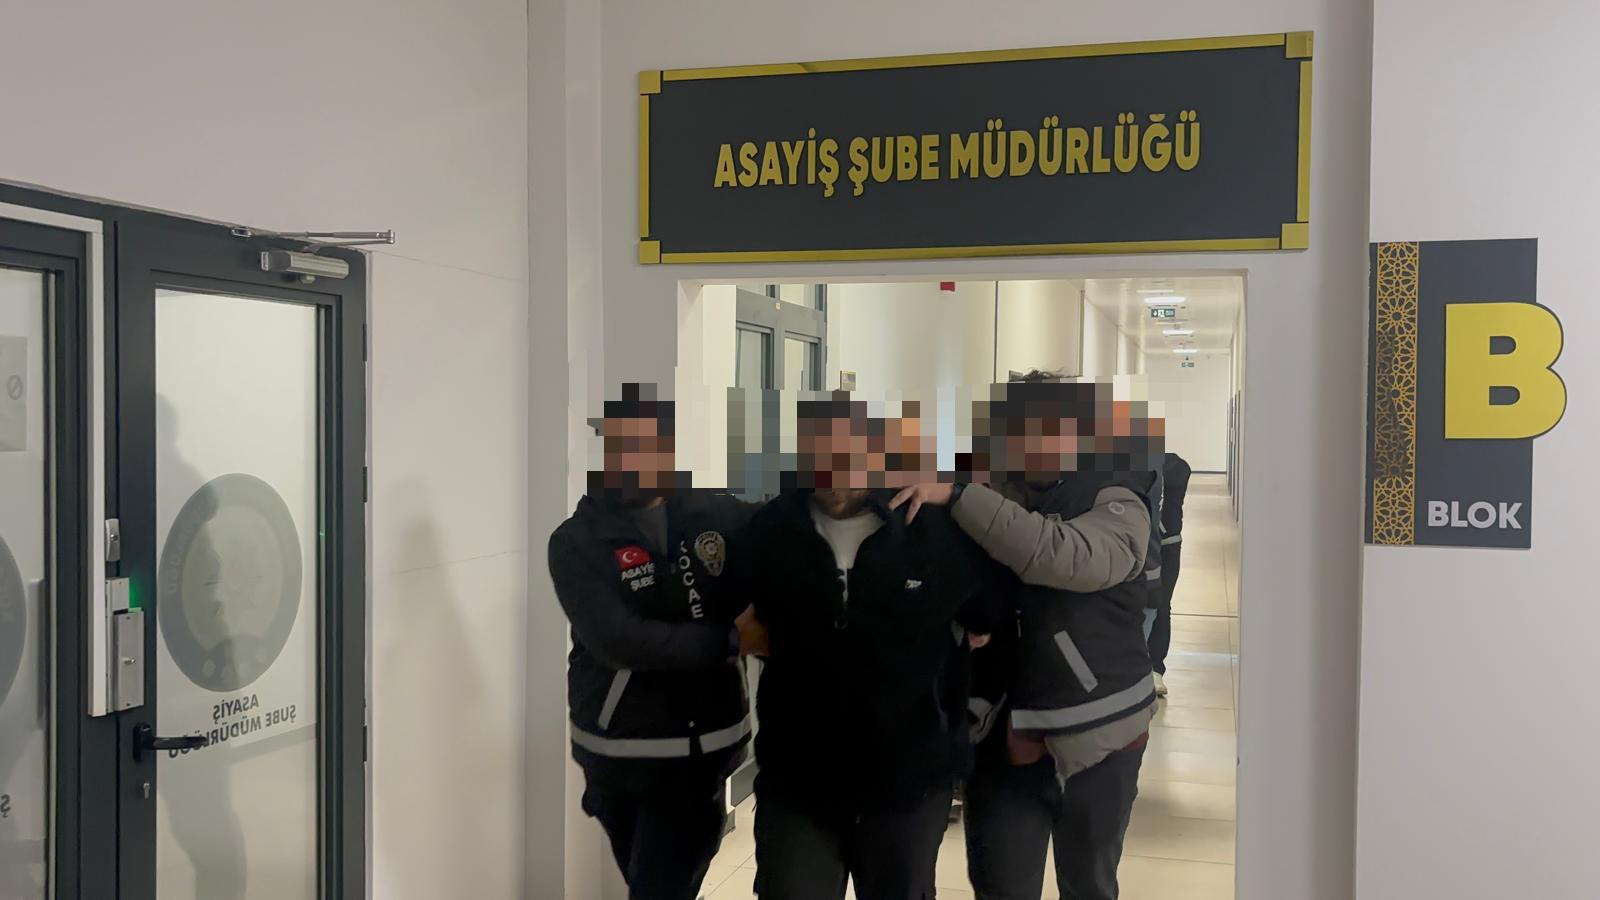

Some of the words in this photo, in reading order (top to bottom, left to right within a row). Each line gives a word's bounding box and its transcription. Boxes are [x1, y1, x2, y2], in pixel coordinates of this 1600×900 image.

[713, 127, 840, 198] ASAYİŞ
[847, 133, 940, 197] ŞUBE
[949, 109, 1200, 179] MÜDÜRLÜĞÜ
[1445, 302, 1567, 439] B
[1427, 500, 1523, 529] BLOK
